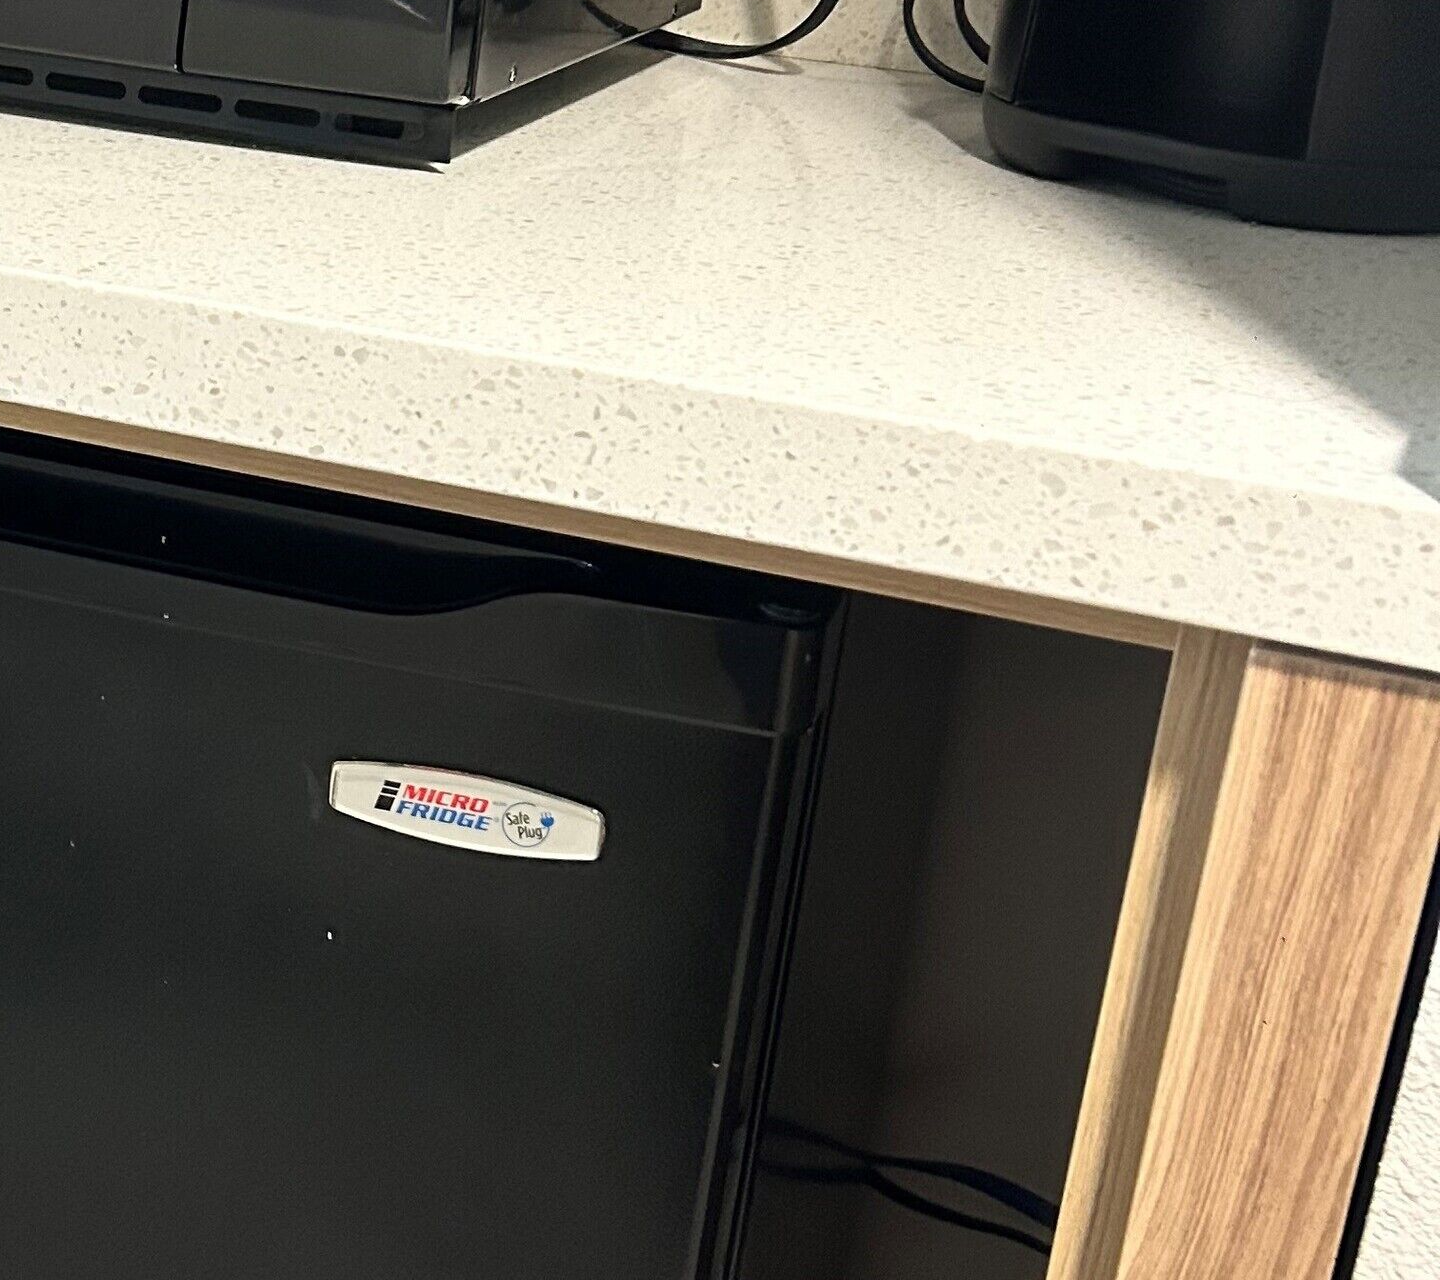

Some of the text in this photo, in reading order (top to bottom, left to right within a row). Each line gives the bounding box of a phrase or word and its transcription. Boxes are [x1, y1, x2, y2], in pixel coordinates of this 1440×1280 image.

[402, 783, 490, 814] MICRO
[396, 800, 493, 832] FRIDGE
[505, 811, 530, 826] Safe
[517, 825, 543, 840] Plug
